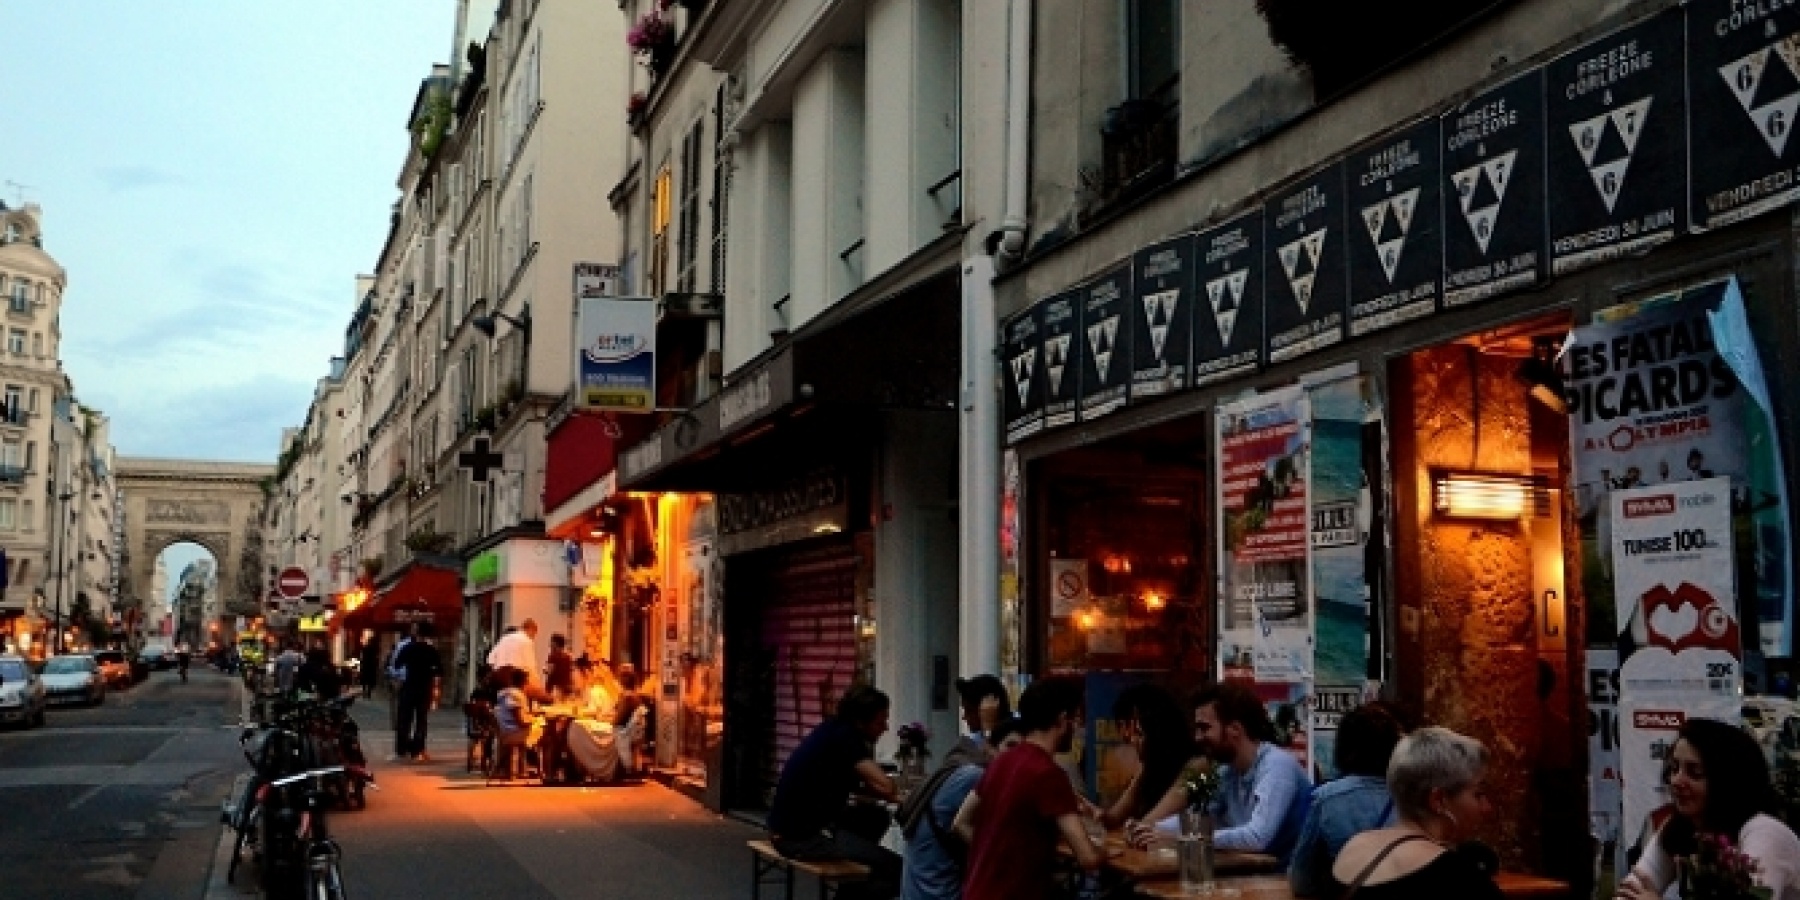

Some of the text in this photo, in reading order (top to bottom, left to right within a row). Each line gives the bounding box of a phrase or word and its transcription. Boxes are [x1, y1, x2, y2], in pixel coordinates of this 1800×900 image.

[1576, 39, 1637, 80] FREEZE
[1564, 50, 1653, 101] CORLEONE
[1580, 126, 1594, 150] 6
[1767, 109, 1785, 138] 6
[1603, 171, 1617, 196] 6
[1561, 352, 1737, 424] PICARDS
[1673, 527, 1706, 552] 100
